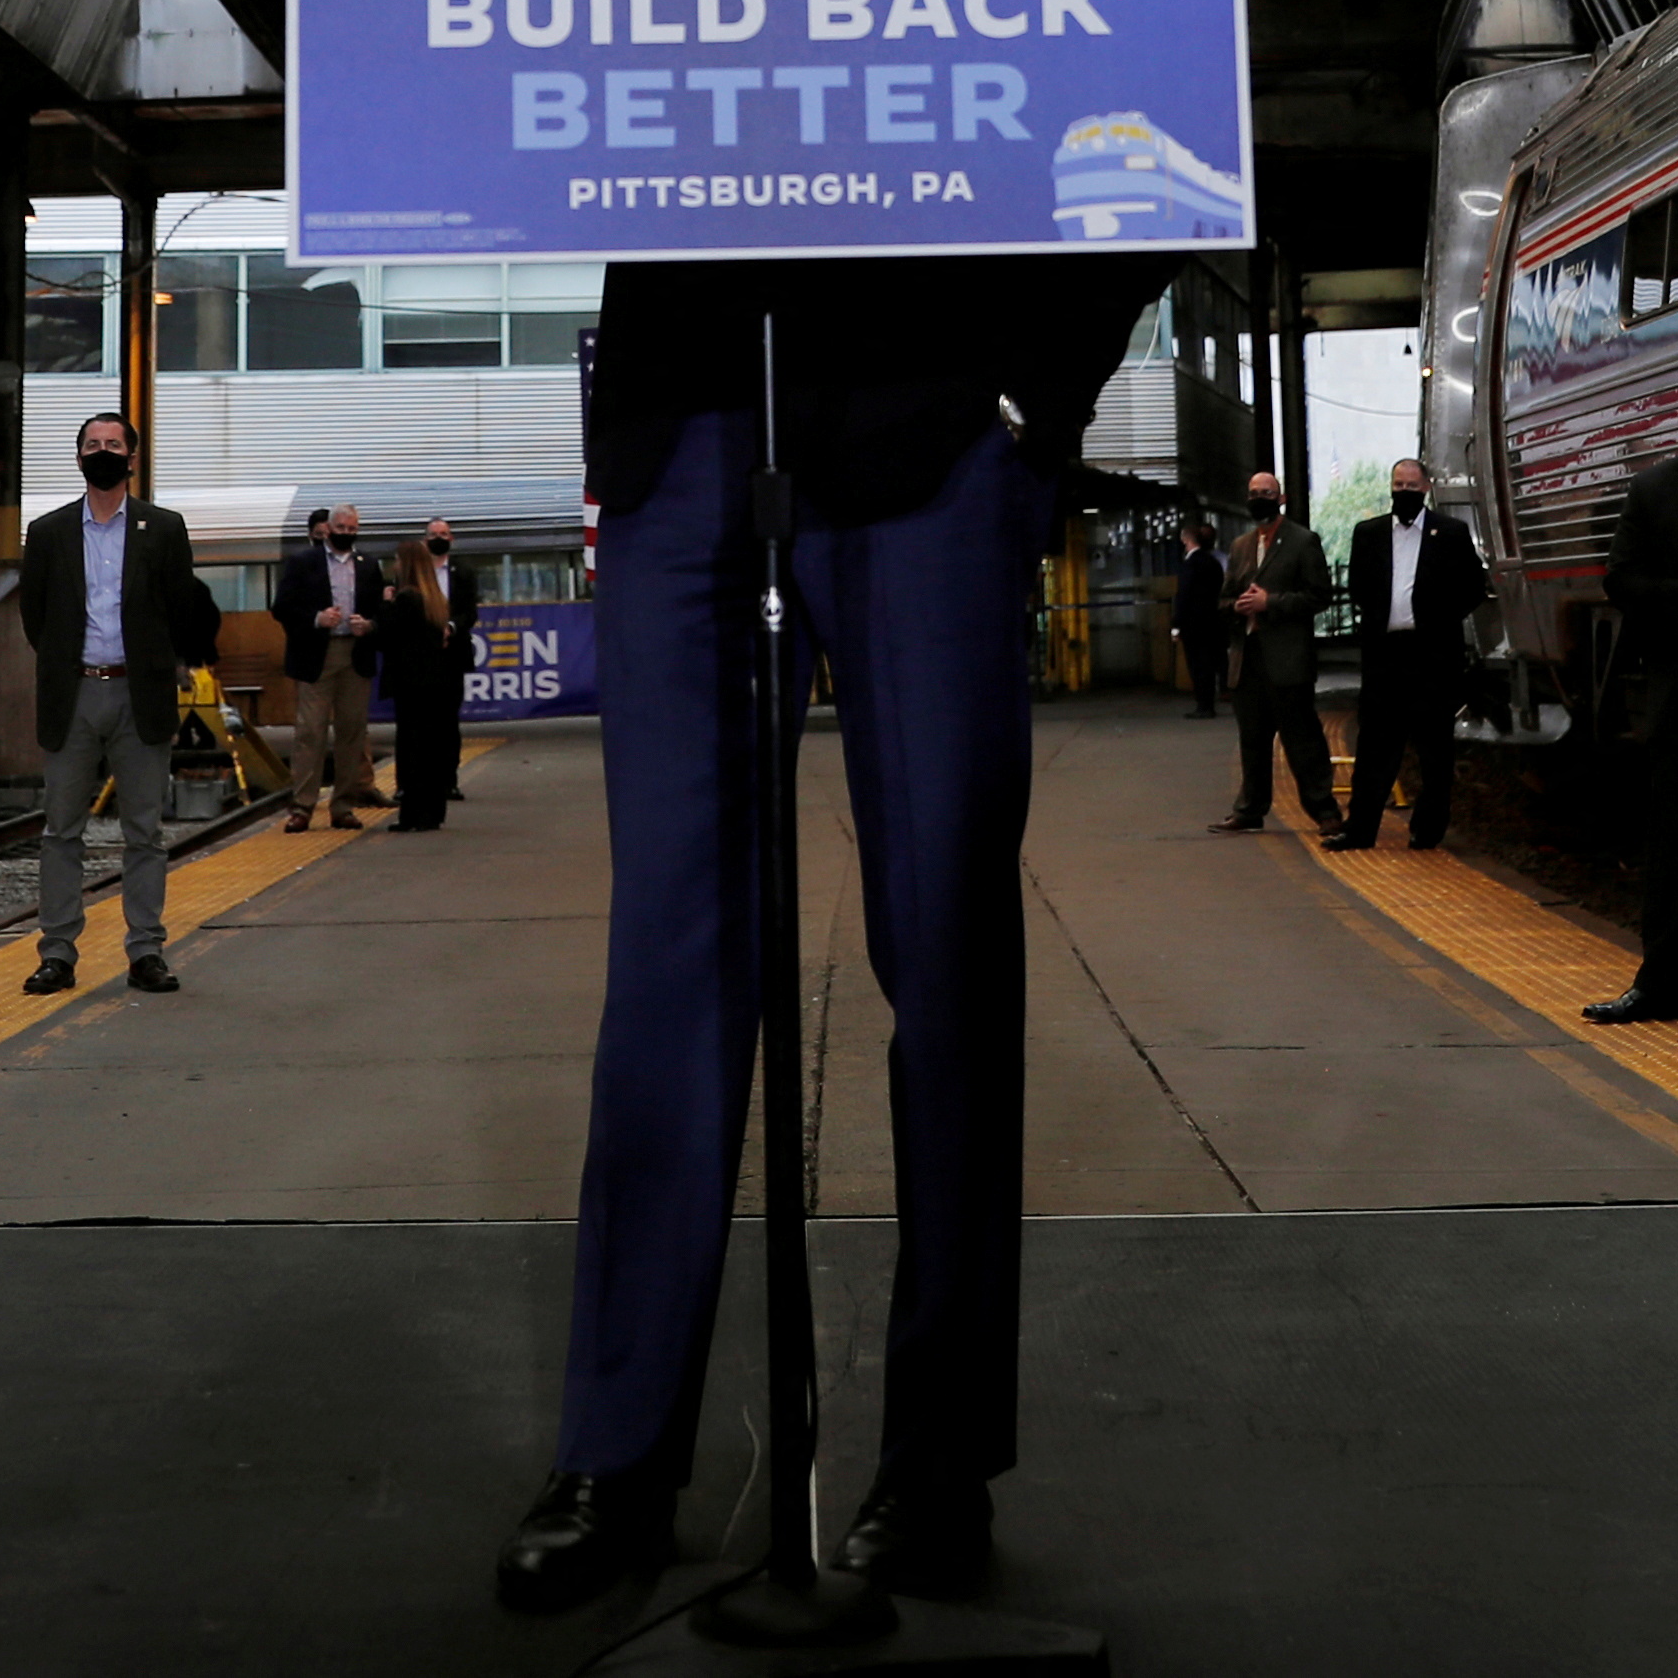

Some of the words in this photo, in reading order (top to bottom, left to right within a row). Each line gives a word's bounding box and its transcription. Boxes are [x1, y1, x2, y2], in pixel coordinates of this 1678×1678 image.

[510, 61, 1034, 152] BETTER
[568, 172, 896, 211] PITTSBURGH,
[911, 170, 975, 204] PA
[462, 668, 562, 702] RRIS
